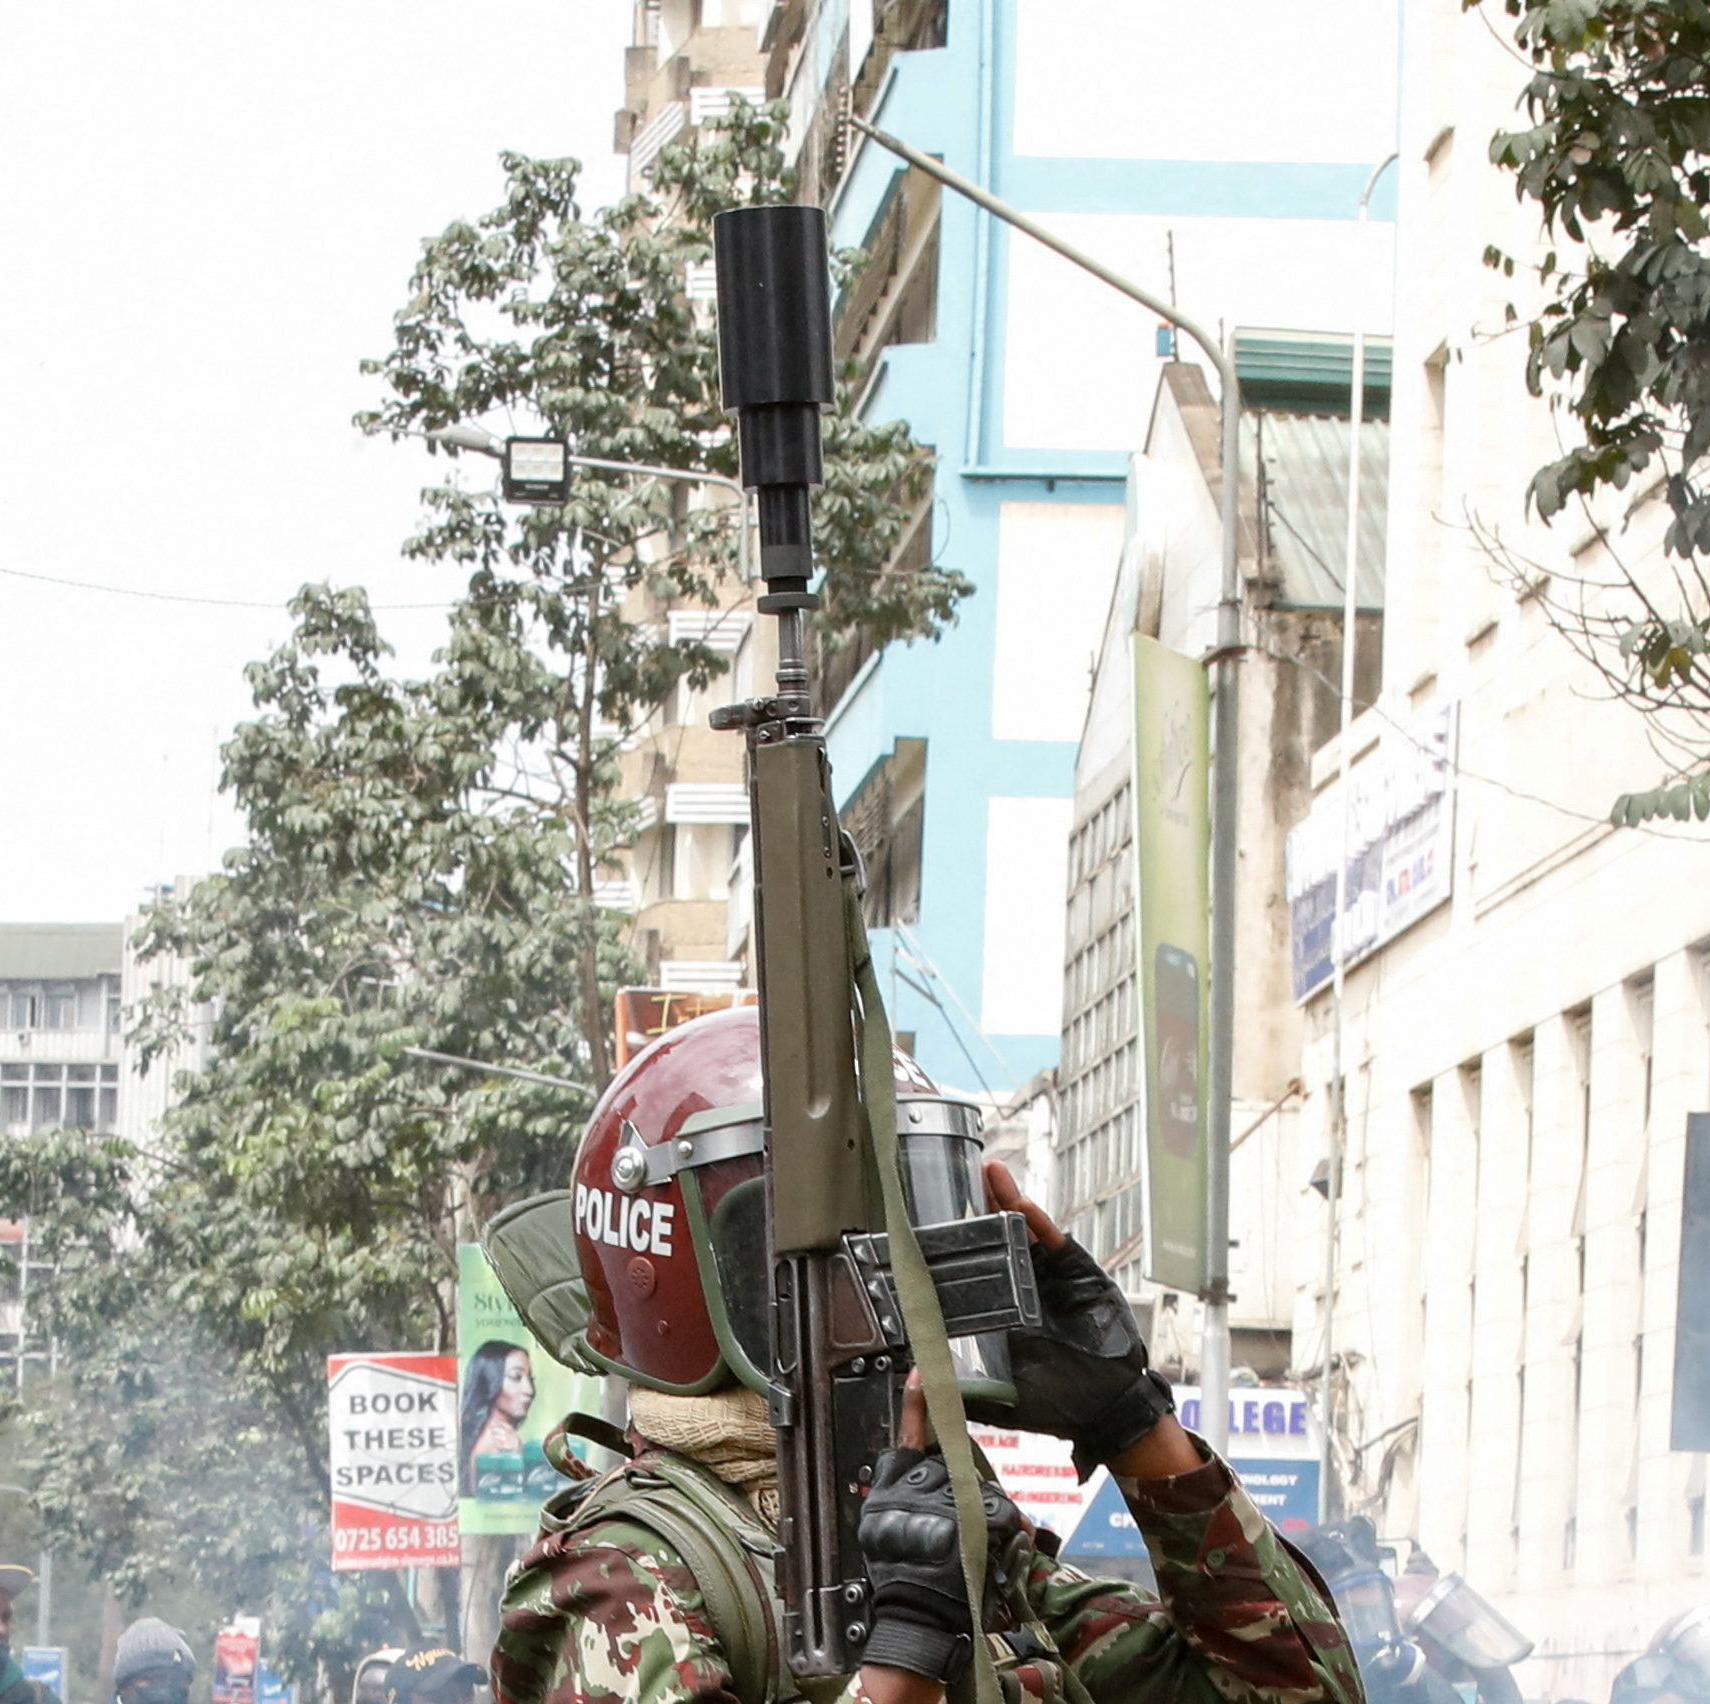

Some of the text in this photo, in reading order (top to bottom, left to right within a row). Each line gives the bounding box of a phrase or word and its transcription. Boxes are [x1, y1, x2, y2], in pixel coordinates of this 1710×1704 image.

[575, 1182, 675, 1257] POLICE
[349, 1391, 438, 1415] BOOK
[343, 1427, 446, 1451] THESE
[336, 1462, 455, 1487] SPACES
[335, 1524, 459, 1551] 0725 654 385
